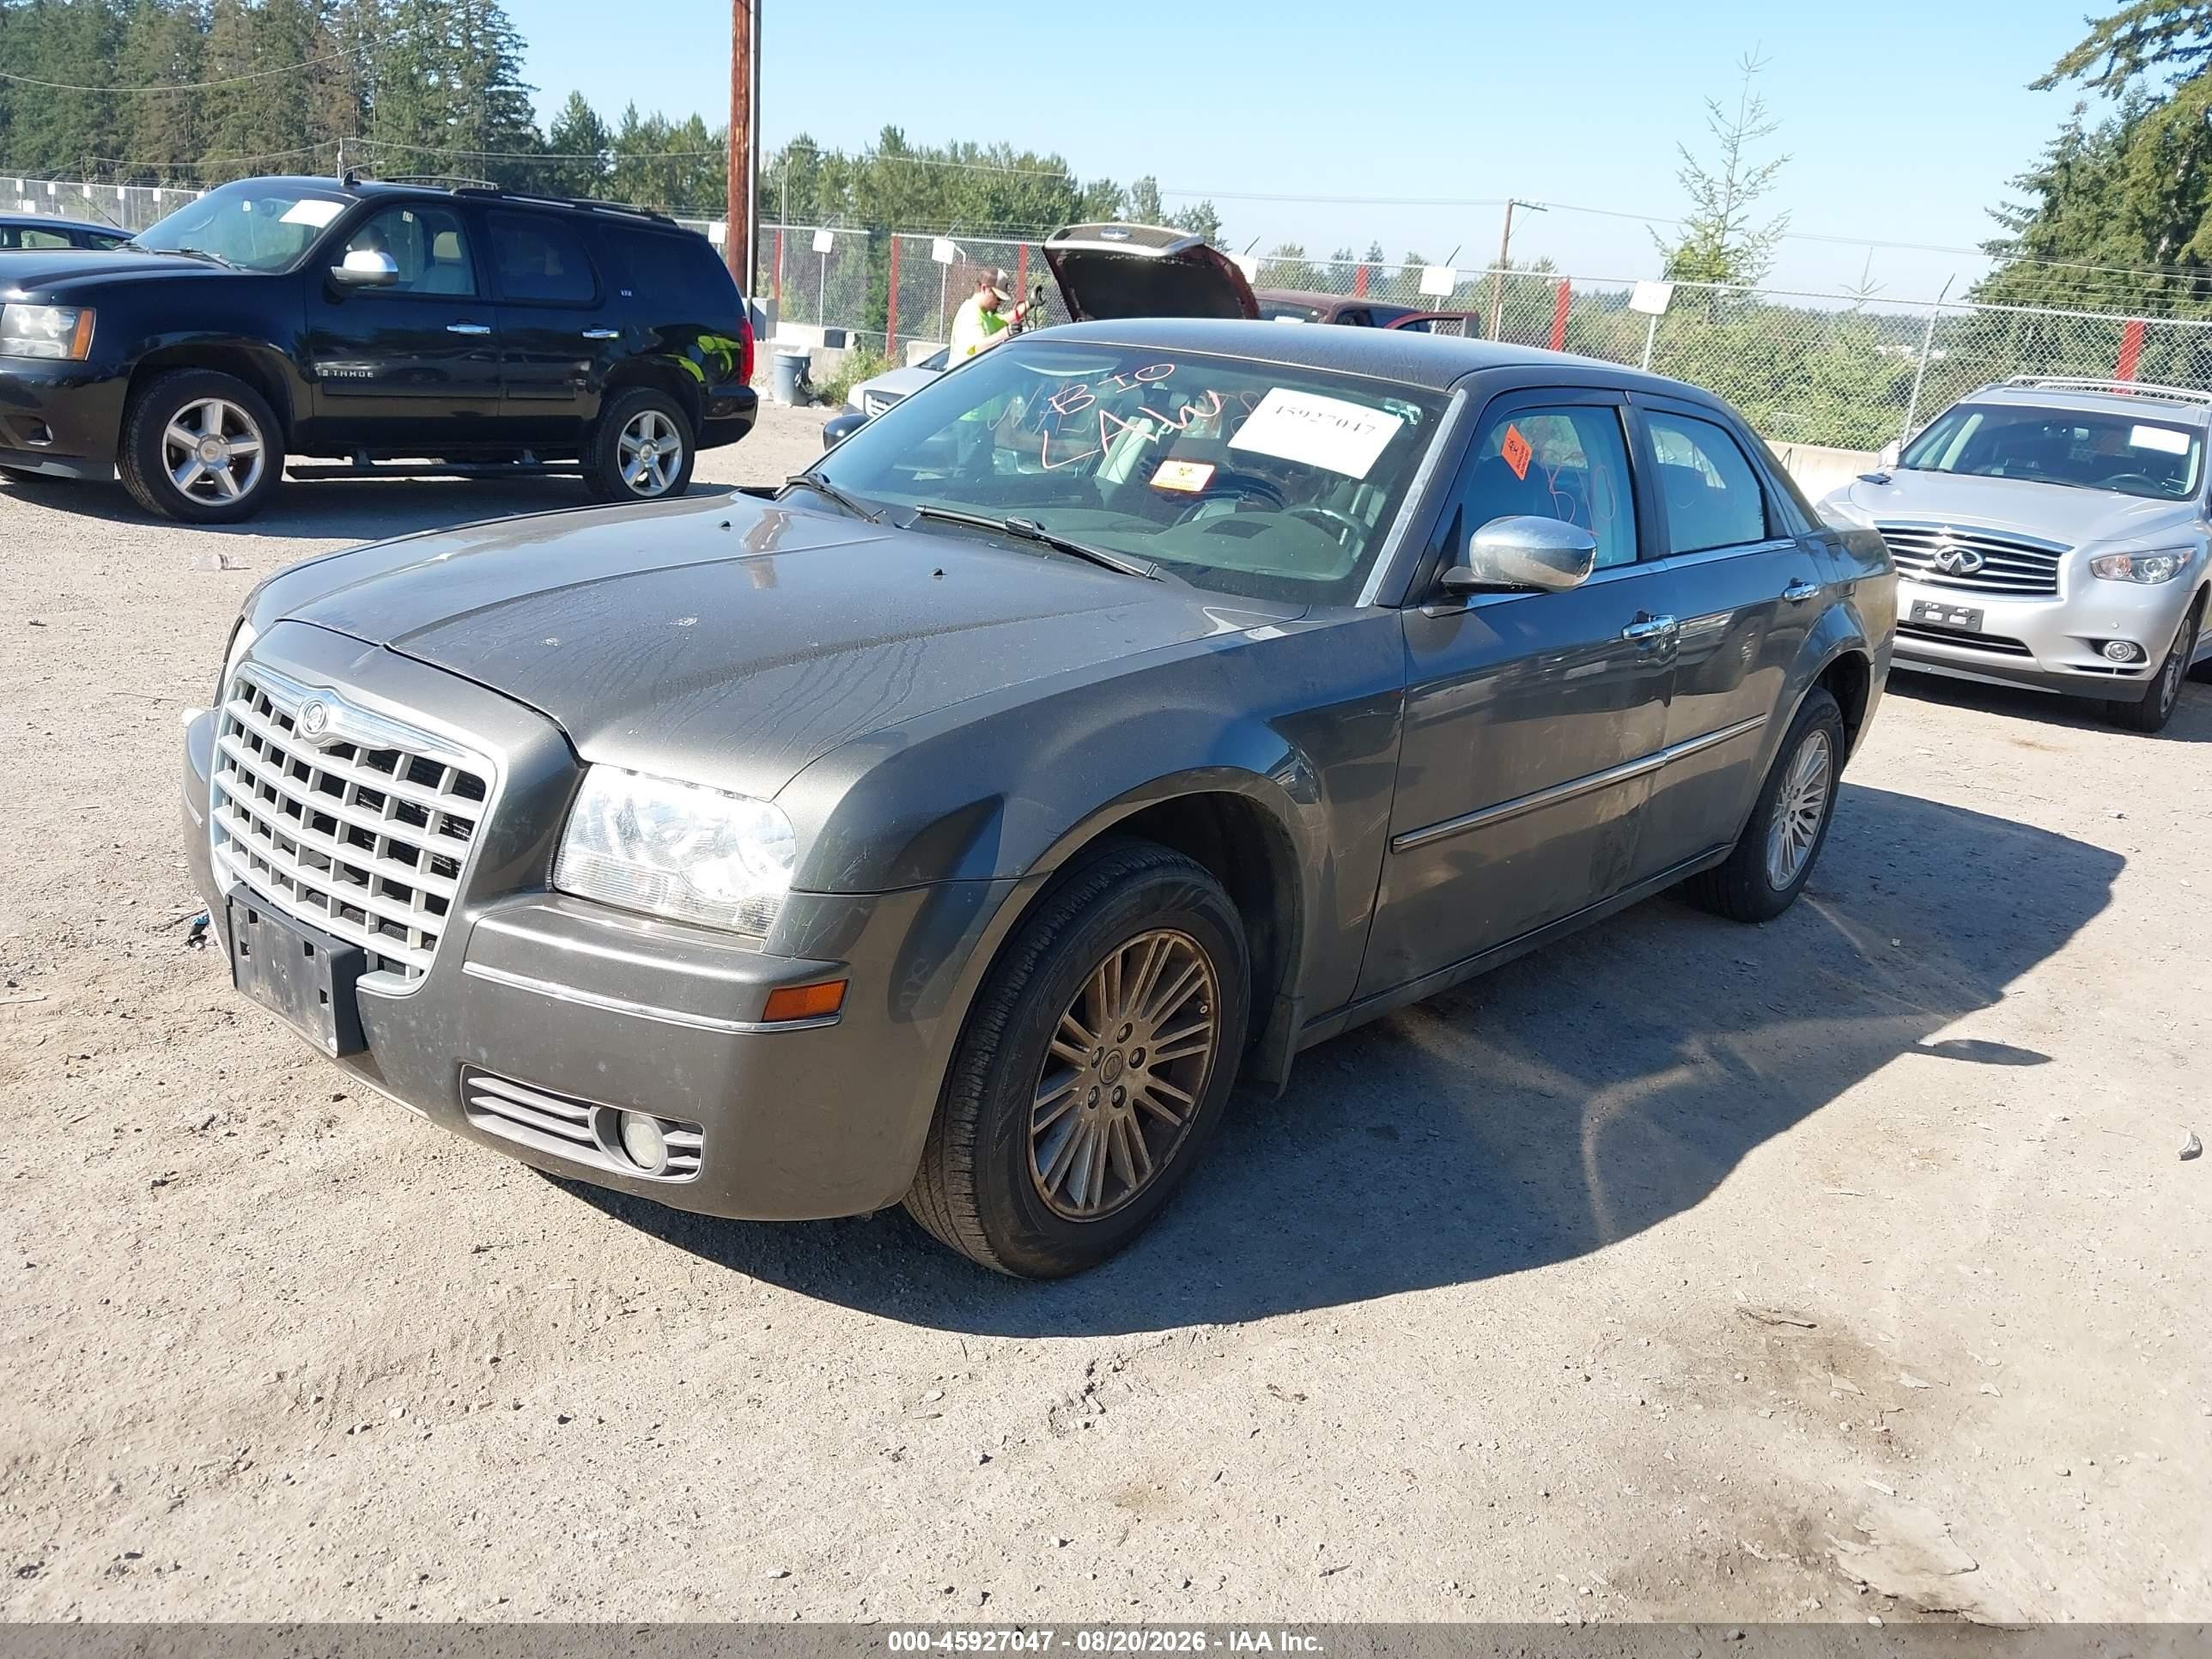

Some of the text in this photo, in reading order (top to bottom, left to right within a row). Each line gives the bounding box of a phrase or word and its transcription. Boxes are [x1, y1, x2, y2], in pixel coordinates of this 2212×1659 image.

[332, 369, 374, 378] TAHOE
[1048, 364, 1175, 416] BIO
[1042, 389, 1221, 470] LAW
